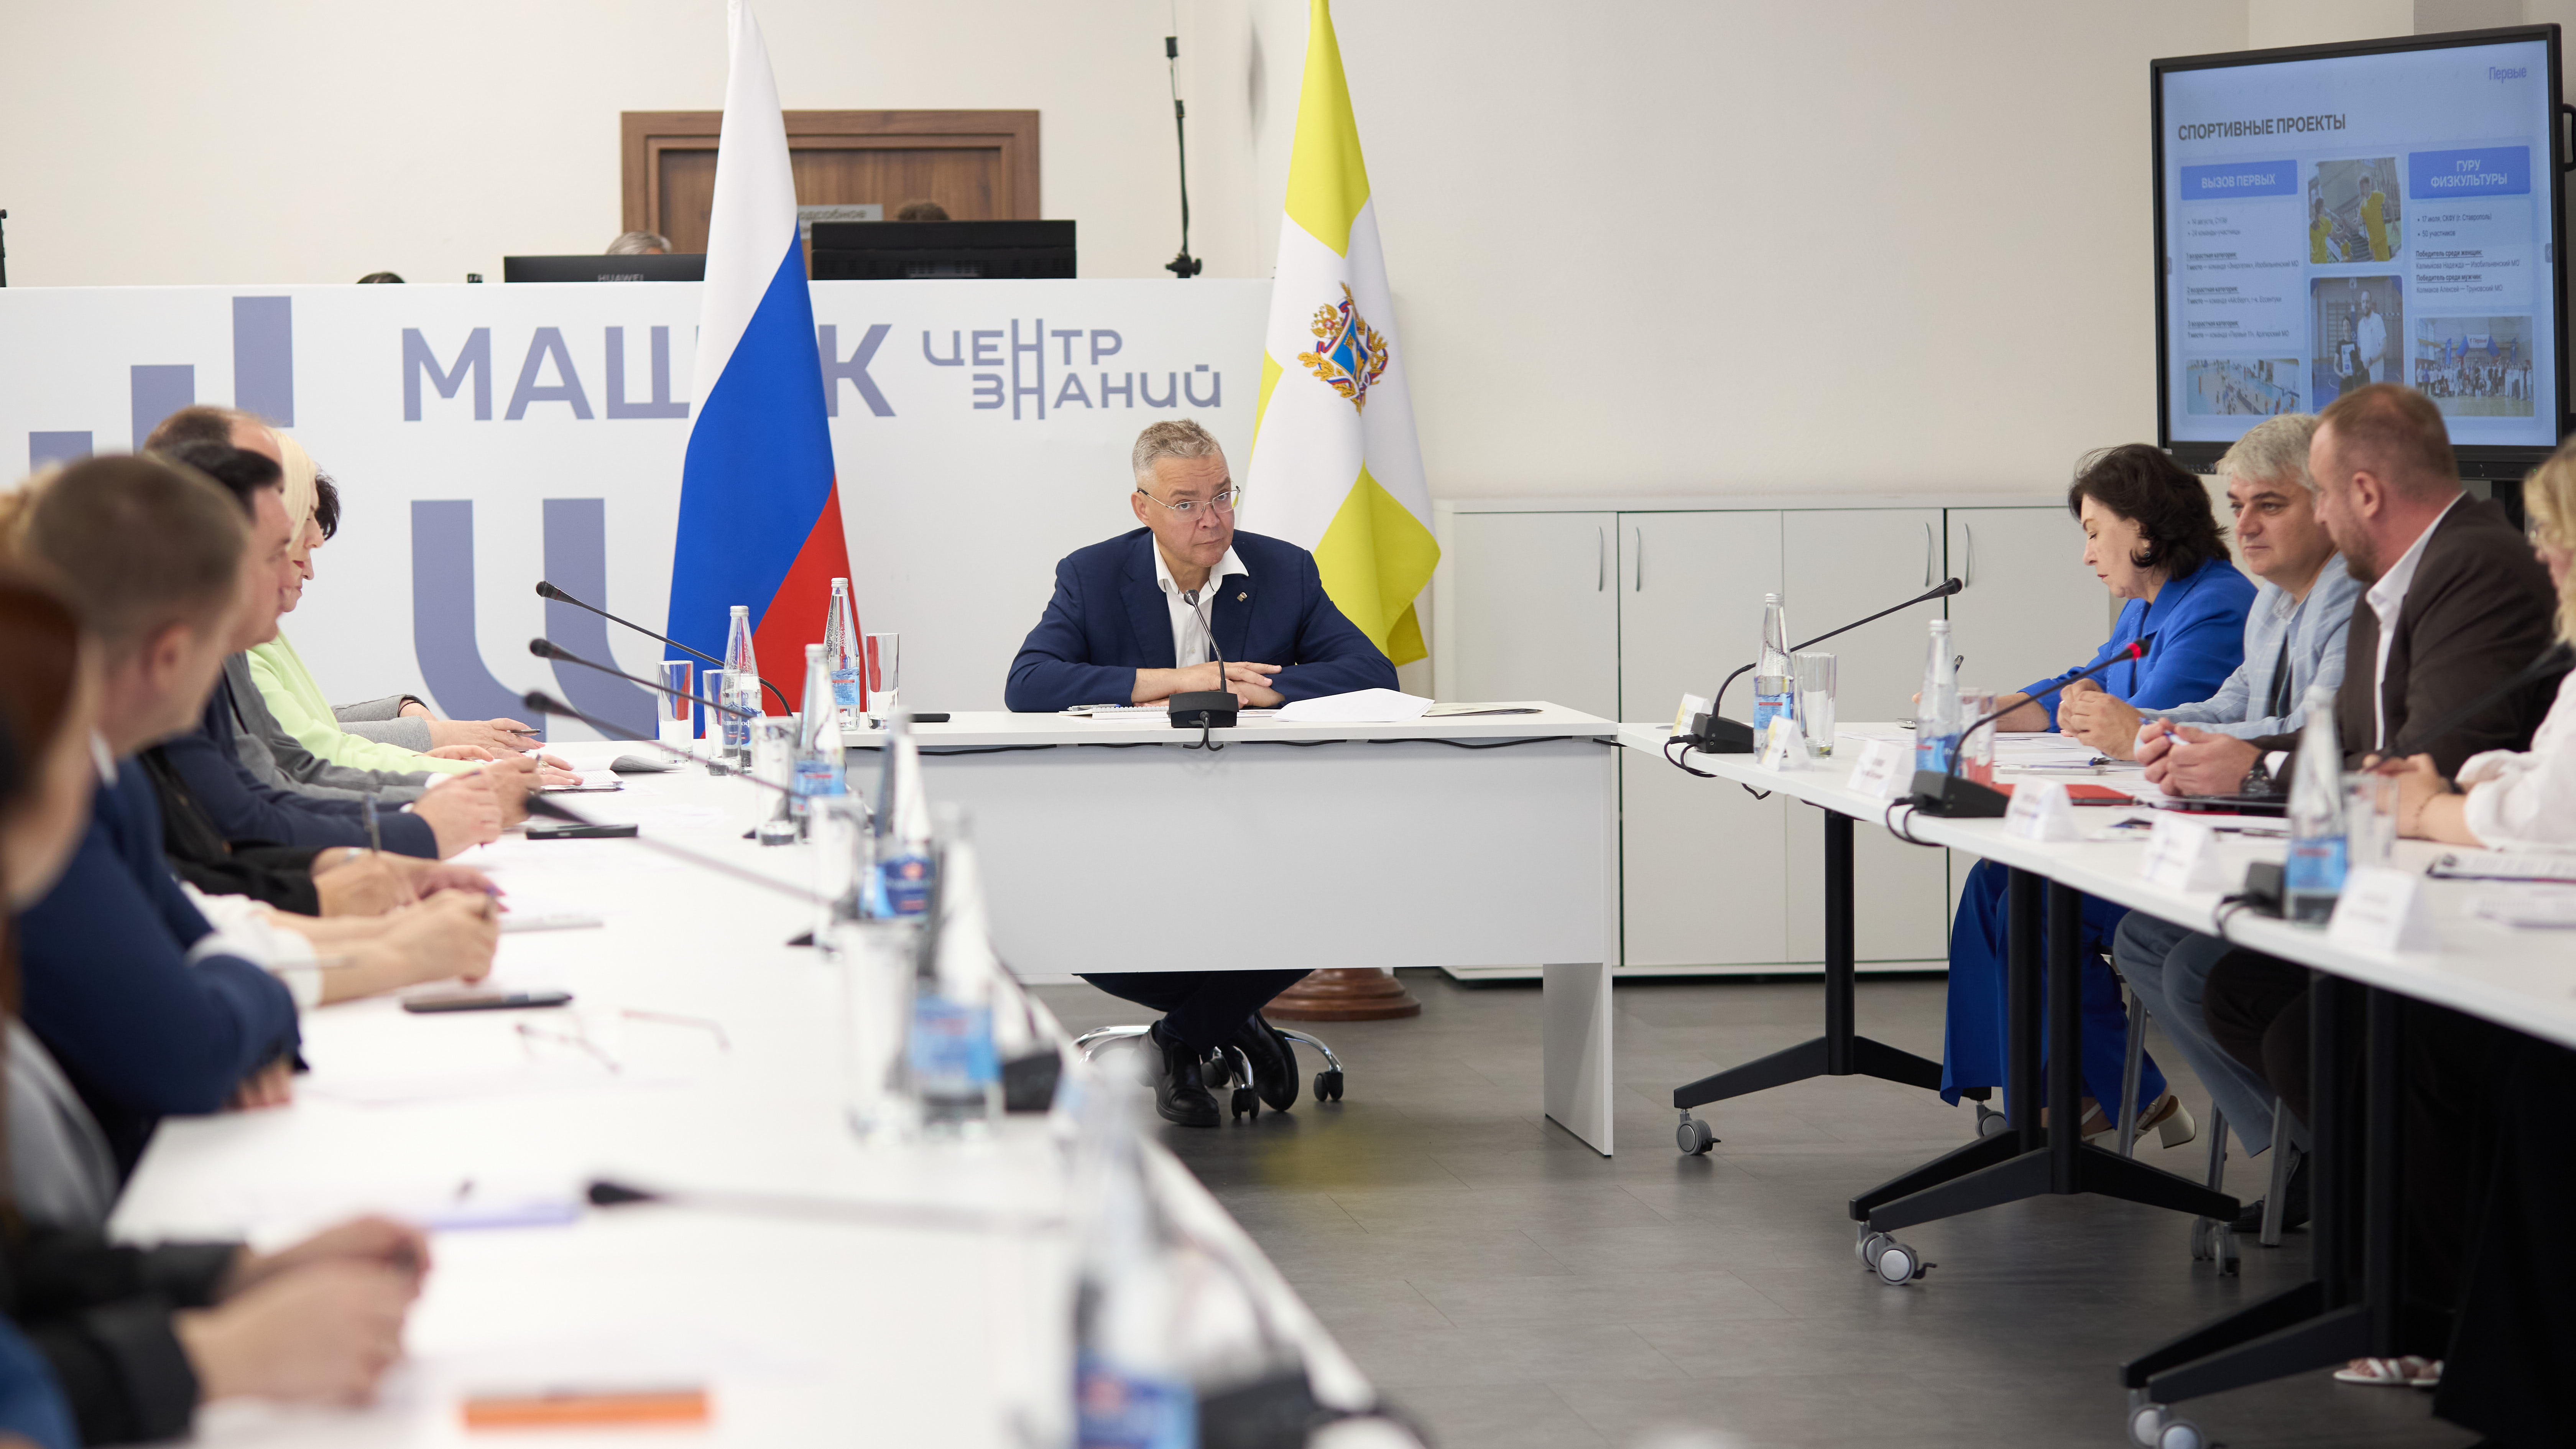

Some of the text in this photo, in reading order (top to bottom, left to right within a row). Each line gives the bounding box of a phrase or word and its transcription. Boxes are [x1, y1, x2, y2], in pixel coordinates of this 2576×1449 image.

[2489, 65, 2527, 84] Первые
[2178, 113, 2346, 141] СПОРТИВНЫЕ ПРОЕКТЫ
[2456, 159, 2481, 173] ГУРУ
[2201, 173, 2276, 189] ВЫЗОВ ПЕРВЫХ
[2430, 173, 2508, 188] ФИЗКУЛЬТУРЫ
[598, 273, 644, 281] HUAWEI
[922, 318, 1123, 367] ЦЕНТР
[402, 324, 896, 421] МАШК
[973, 364, 1221, 420] ЗНАНИЙ
